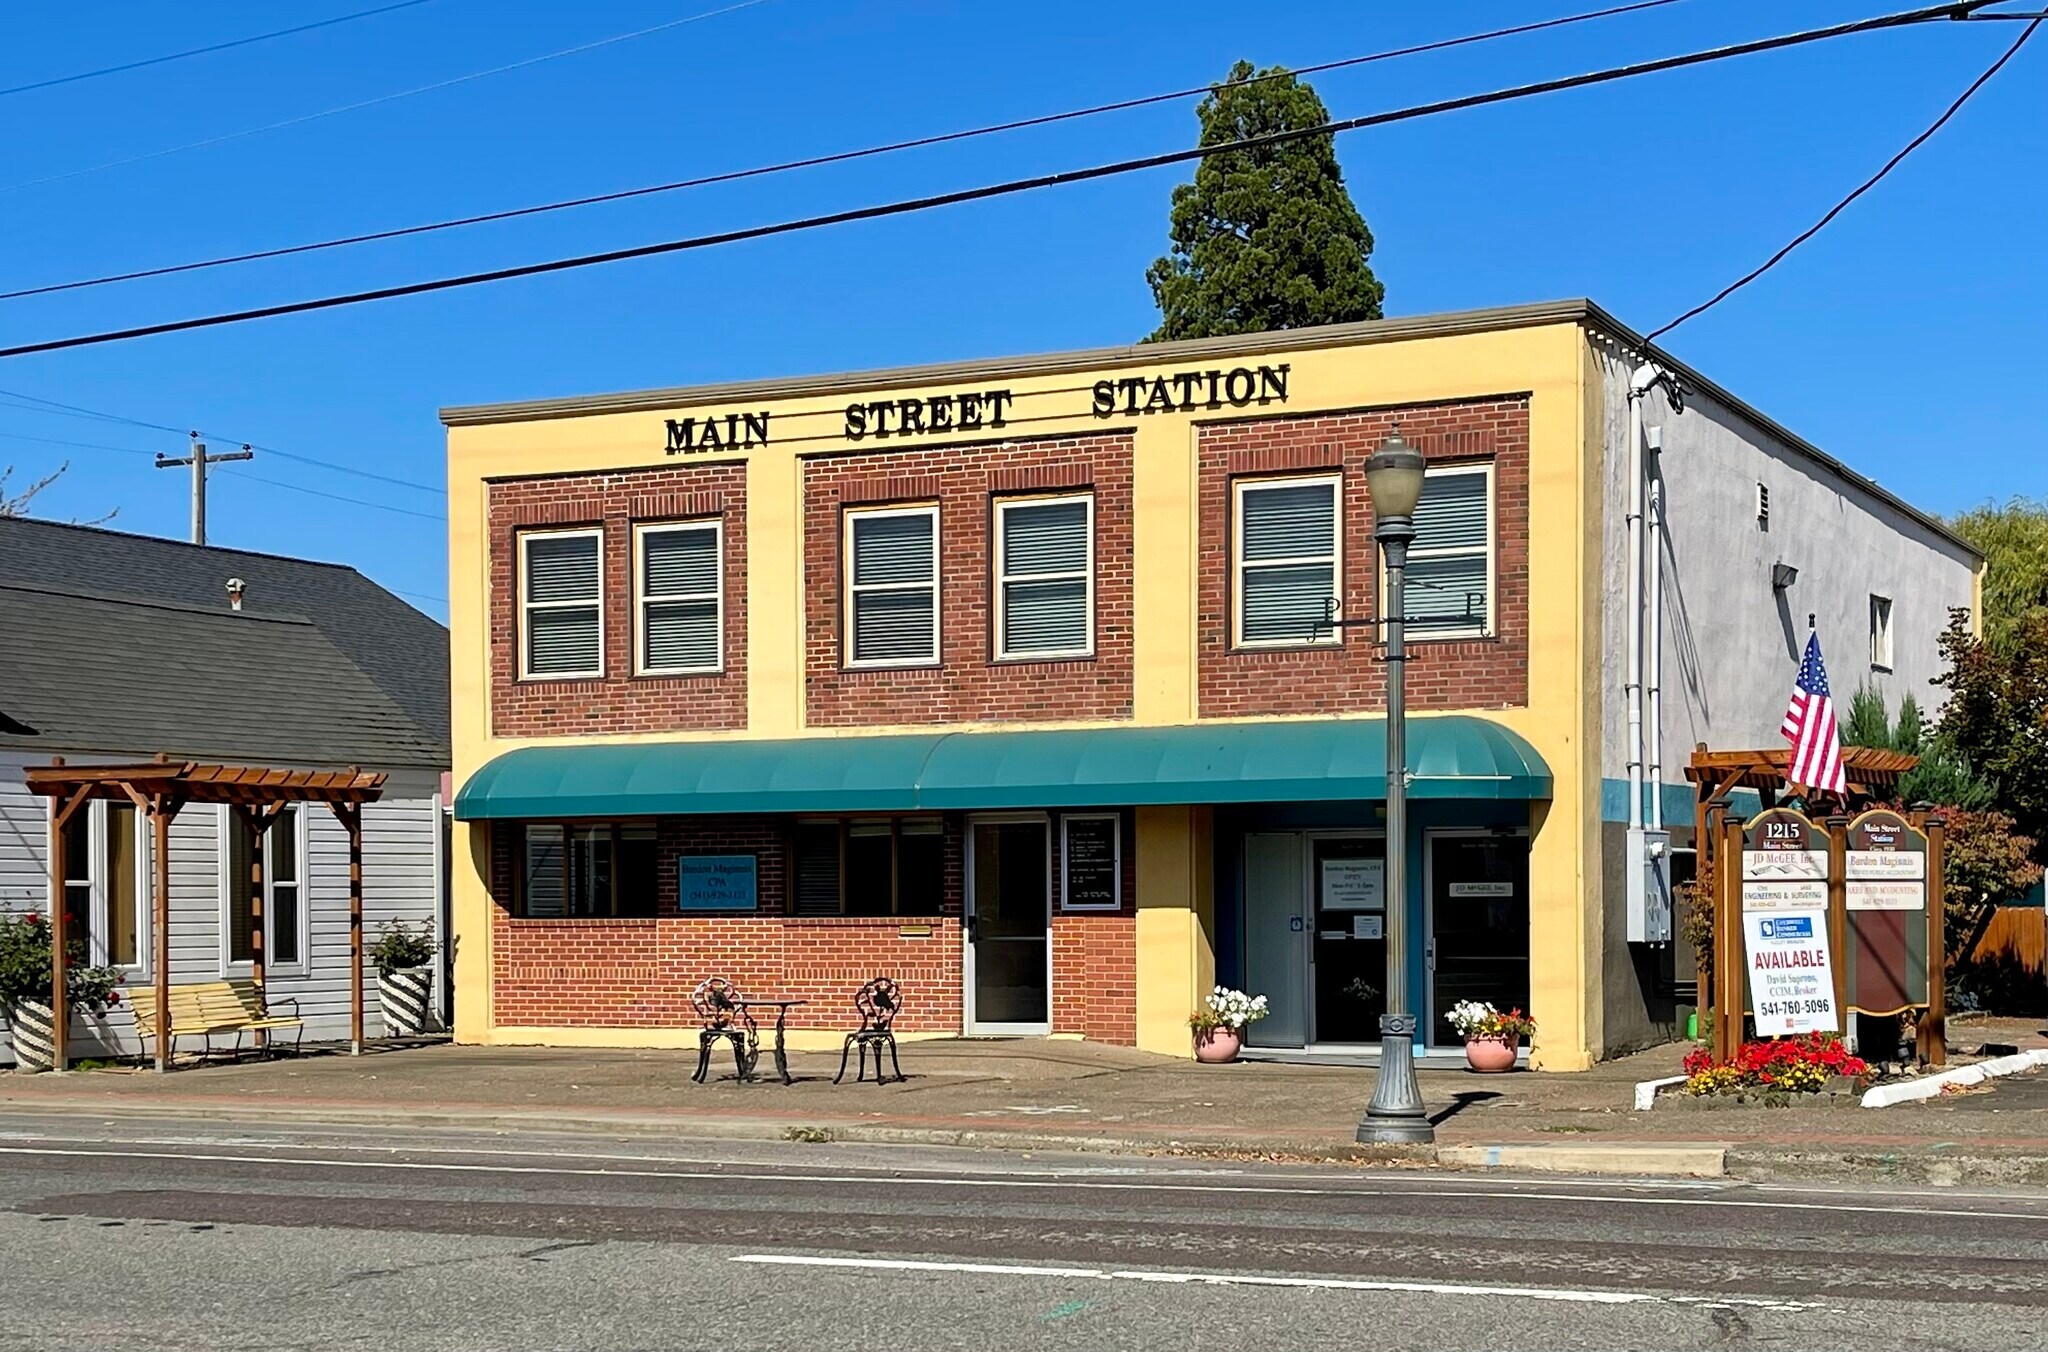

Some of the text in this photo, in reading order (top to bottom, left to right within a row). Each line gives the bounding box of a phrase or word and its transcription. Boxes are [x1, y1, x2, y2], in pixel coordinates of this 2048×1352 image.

[665, 364, 1290, 453] MAIN STREET STATION
[1766, 823, 1799, 838] 1215
[1864, 823, 1900, 833] Main Street
[1763, 841, 1802, 849] Main Street
[1753, 853, 1764, 866] JD
[708, 877, 727, 888] CPA
[1880, 886, 1918, 894] ACCOUNTING
[1744, 892, 1782, 900] ENGINEERING
[1755, 949, 1825, 970] AVAILABLE
[1766, 974, 1787, 985] David
[1794, 985, 1817, 996] Broker
[1761, 999, 1829, 1016] 541-760-5096
